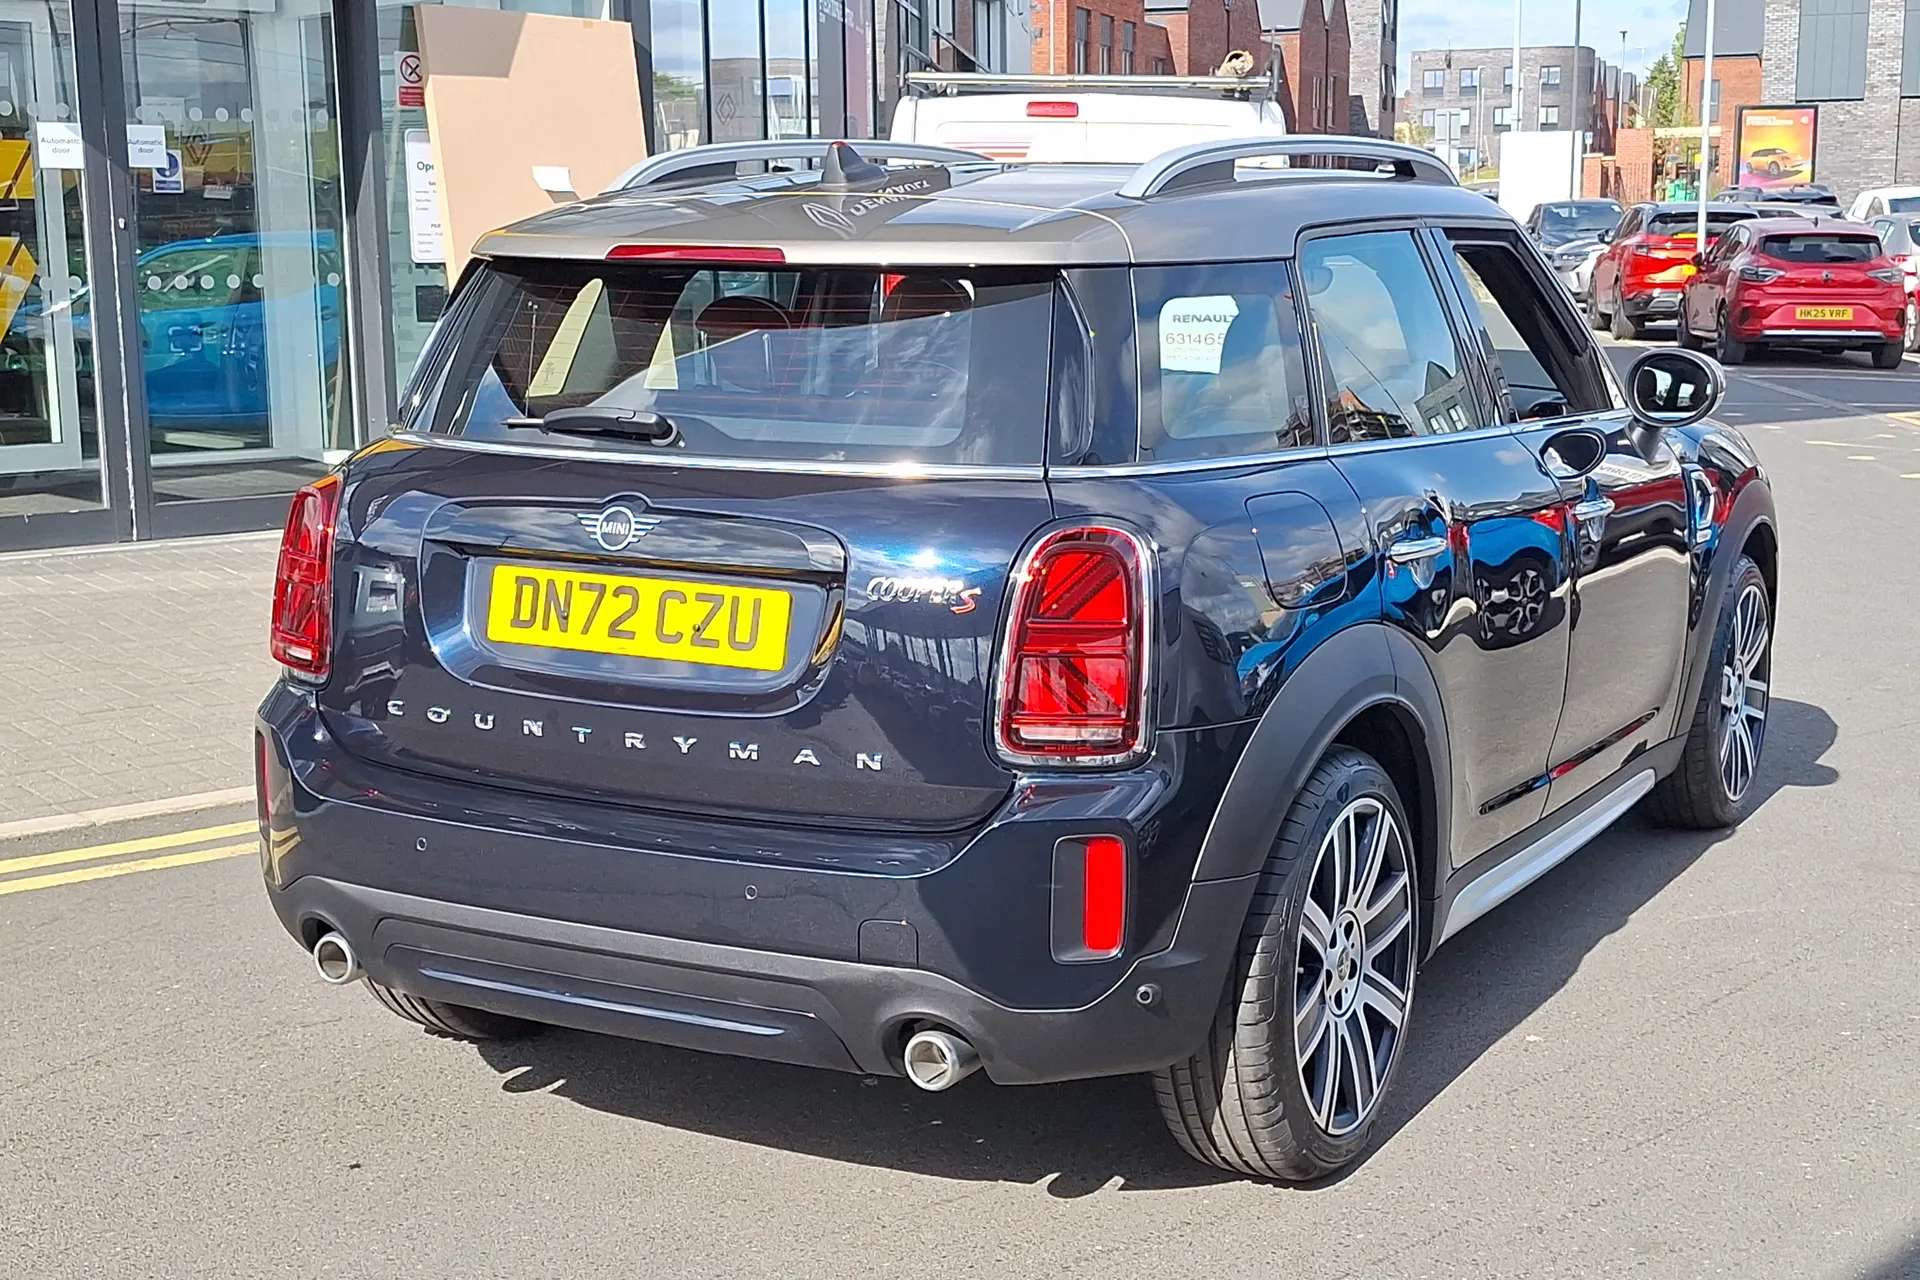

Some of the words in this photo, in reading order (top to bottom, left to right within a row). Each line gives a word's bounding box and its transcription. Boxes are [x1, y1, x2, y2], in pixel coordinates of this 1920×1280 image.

[1799, 308, 1827, 318] HK25
[1829, 308, 1849, 318] VRF
[600, 521, 630, 535] MINI
[510, 575, 640, 640] DN72
[655, 589, 762, 651] CZU
[386, 699, 884, 772] COUNTRYMAN
